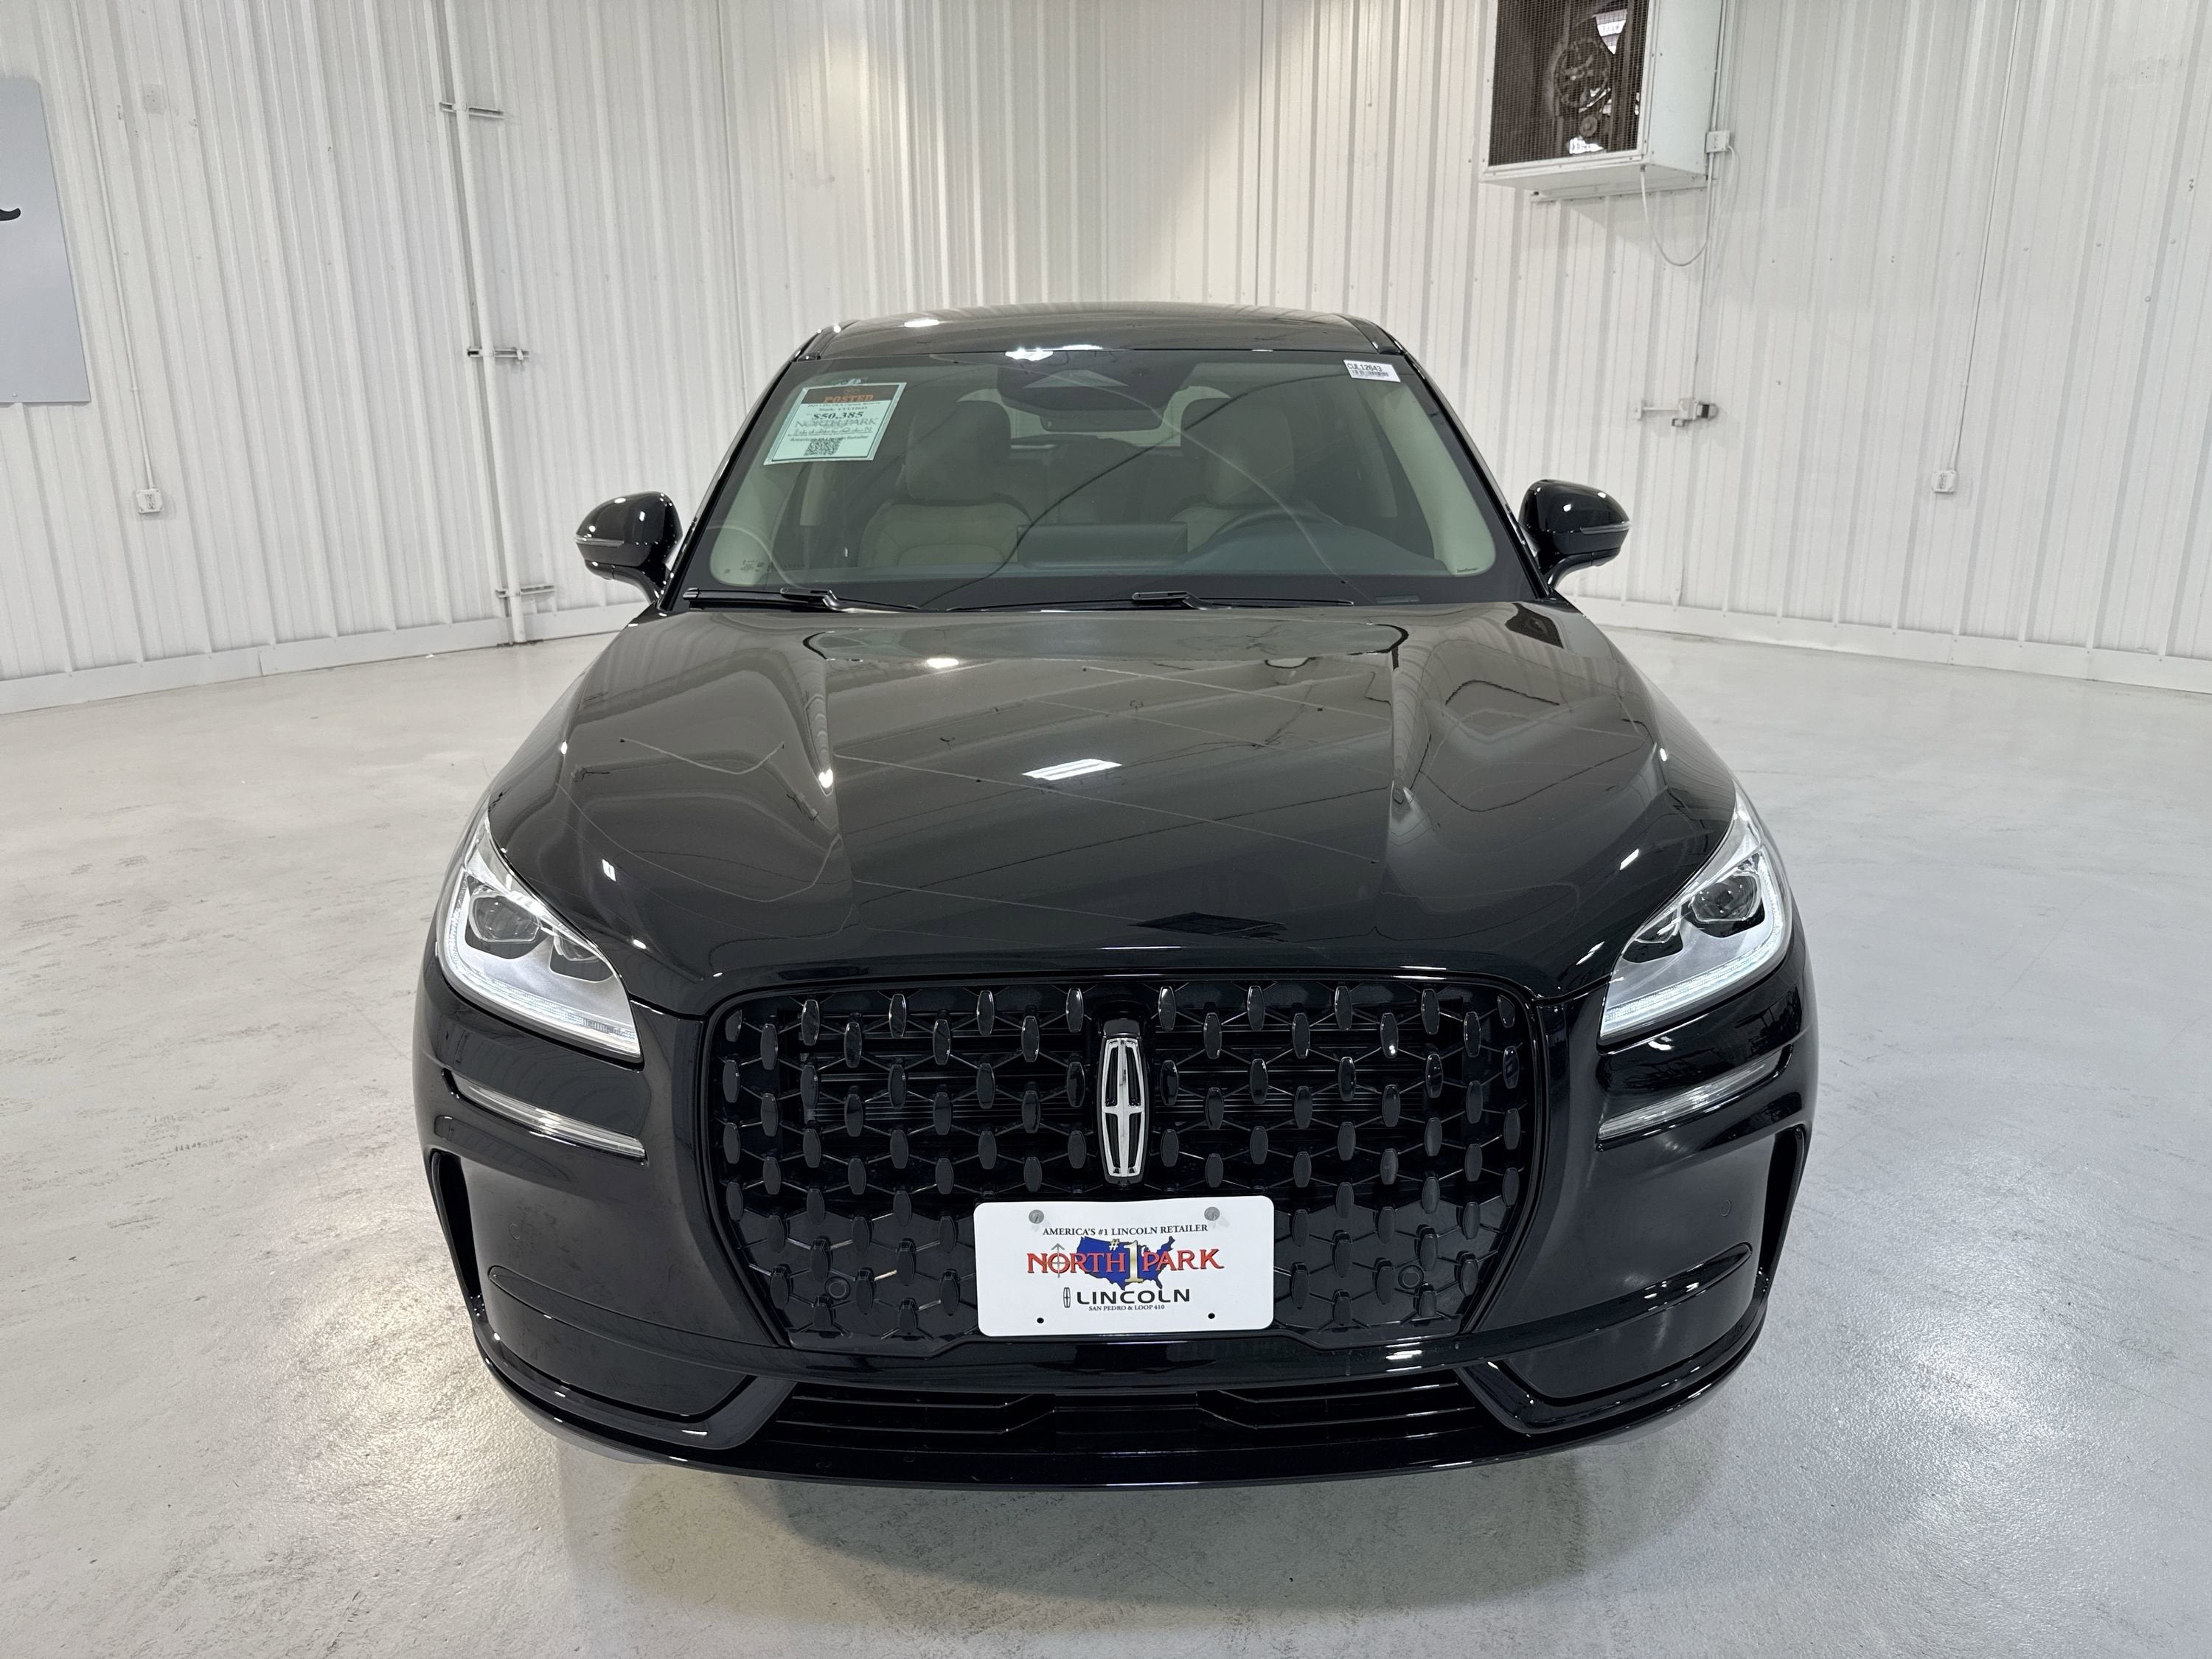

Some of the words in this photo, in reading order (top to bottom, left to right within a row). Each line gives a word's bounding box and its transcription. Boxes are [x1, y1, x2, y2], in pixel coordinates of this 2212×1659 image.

[824, 394, 874, 403] POSTED
[813, 411, 864, 420] $50,385
[1042, 1228, 1096, 1236] AMERICA'S
[1111, 1226, 1158, 1236] LINCOLN
[1160, 1224, 1208, 1234] RETAILER
[1026, 1252, 1126, 1274] NORTH
[1141, 1248, 1225, 1271] PARK
[1077, 1289, 1189, 1304] LINCOLN
